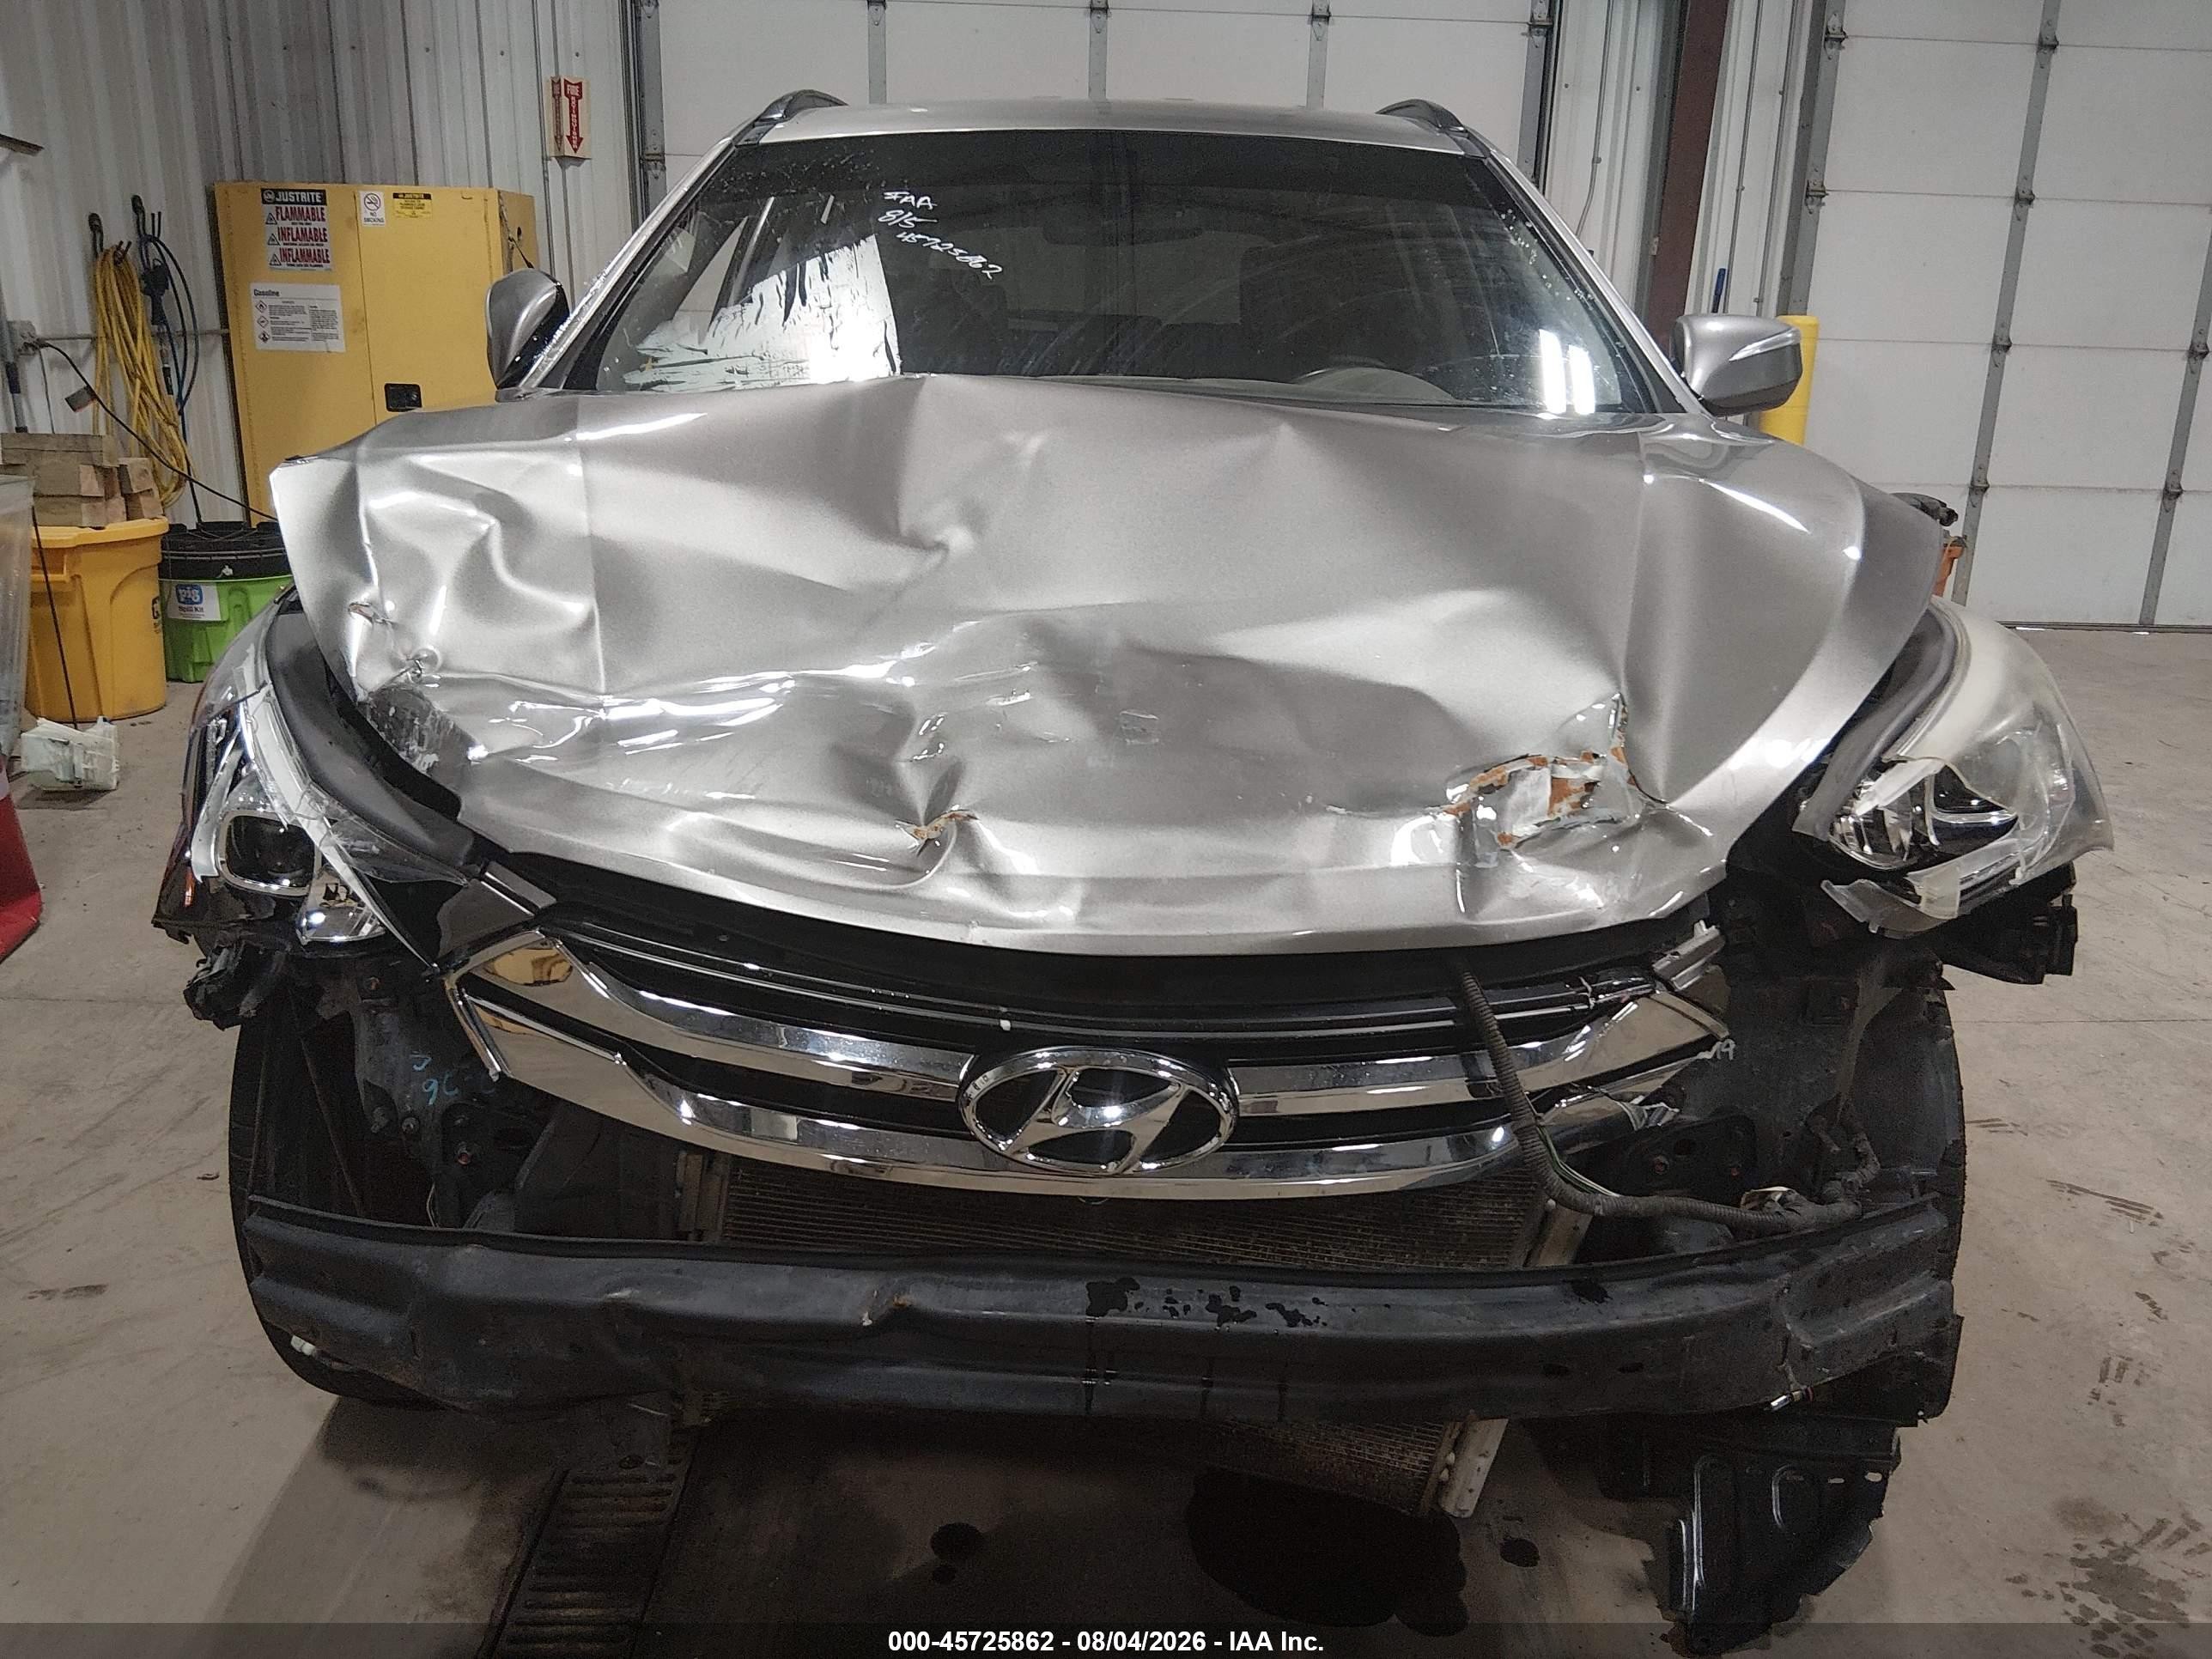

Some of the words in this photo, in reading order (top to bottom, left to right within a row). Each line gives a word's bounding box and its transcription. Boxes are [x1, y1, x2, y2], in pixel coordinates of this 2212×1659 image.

[276, 191, 322, 203] JUSTRITE
[276, 206, 326, 222] FLAMMABLE
[277, 227, 328, 242] INFLAMABLE
[279, 247, 331, 264] INFLAMMABLE
[179, 586, 200, 603] pig
